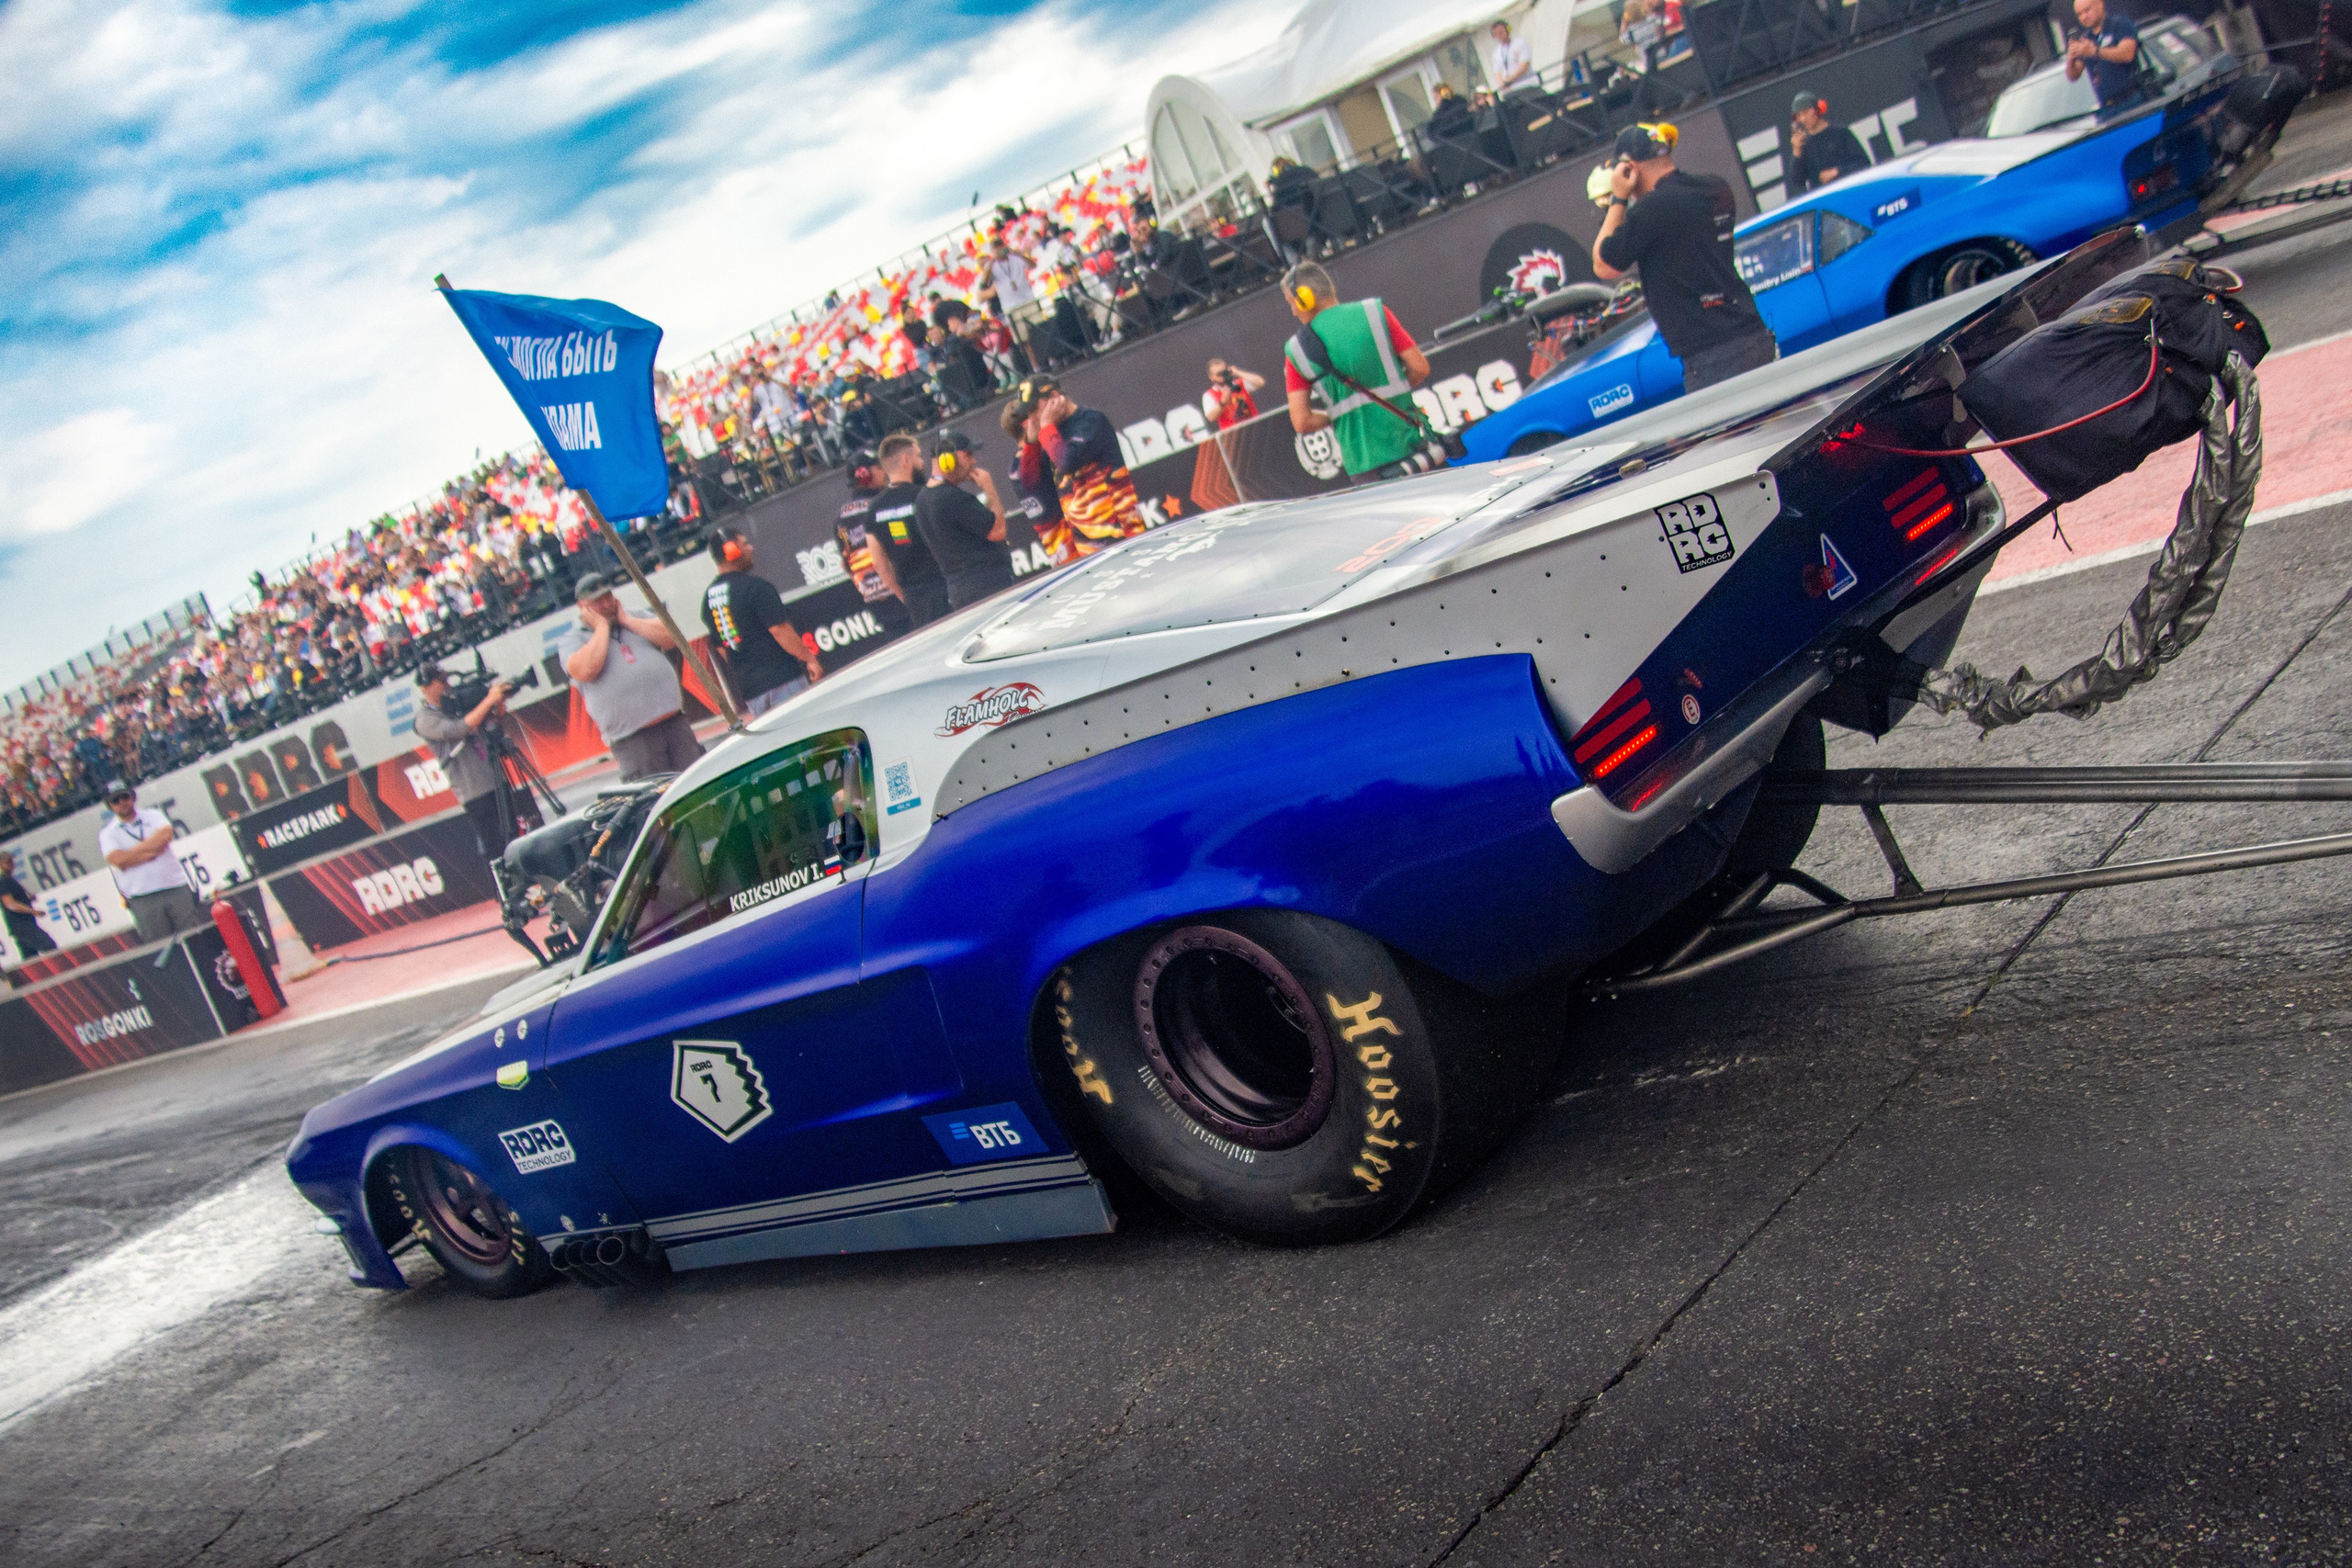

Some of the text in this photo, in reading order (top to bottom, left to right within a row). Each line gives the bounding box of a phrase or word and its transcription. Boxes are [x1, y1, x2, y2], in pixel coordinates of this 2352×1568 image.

[1681, 550, 1733, 572] TECHNOLOGY
[262, 803, 343, 849] RACEPARK
[352, 856, 446, 917] RDRC
[729, 863, 824, 912] KRIKSUNOV I.
[61, 894, 102, 932] ВТБ
[74, 1005, 154, 1046] ROSGONKI
[689, 1059, 713, 1074] RDRC
[699, 1073, 722, 1103] 7
[1326, 990, 1419, 1193] Hoosier
[501, 1122, 566, 1160] RDRC
[968, 1121, 1022, 1150] ВТБ
[515, 1150, 571, 1173] TECHNOLOGY
